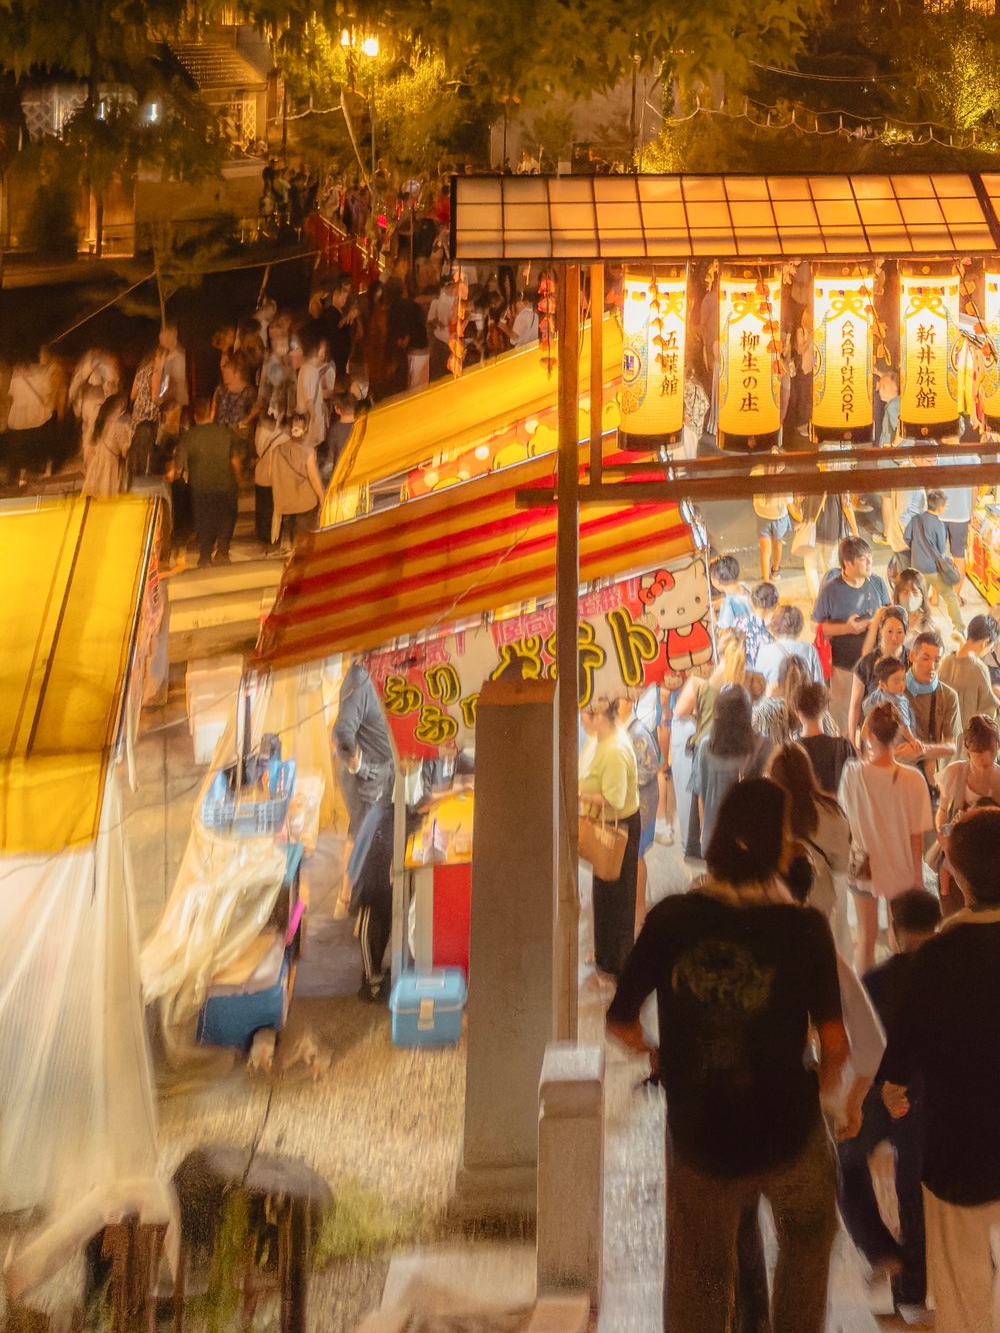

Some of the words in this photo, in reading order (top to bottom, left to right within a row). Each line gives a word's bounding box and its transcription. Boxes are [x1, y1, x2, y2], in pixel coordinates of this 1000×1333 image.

[739, 330, 760, 412] 柳生の庄
[841, 319, 855, 366] AKARI
[915, 323, 937, 409] 新井旅館
[841, 375, 855, 422] KAORI
